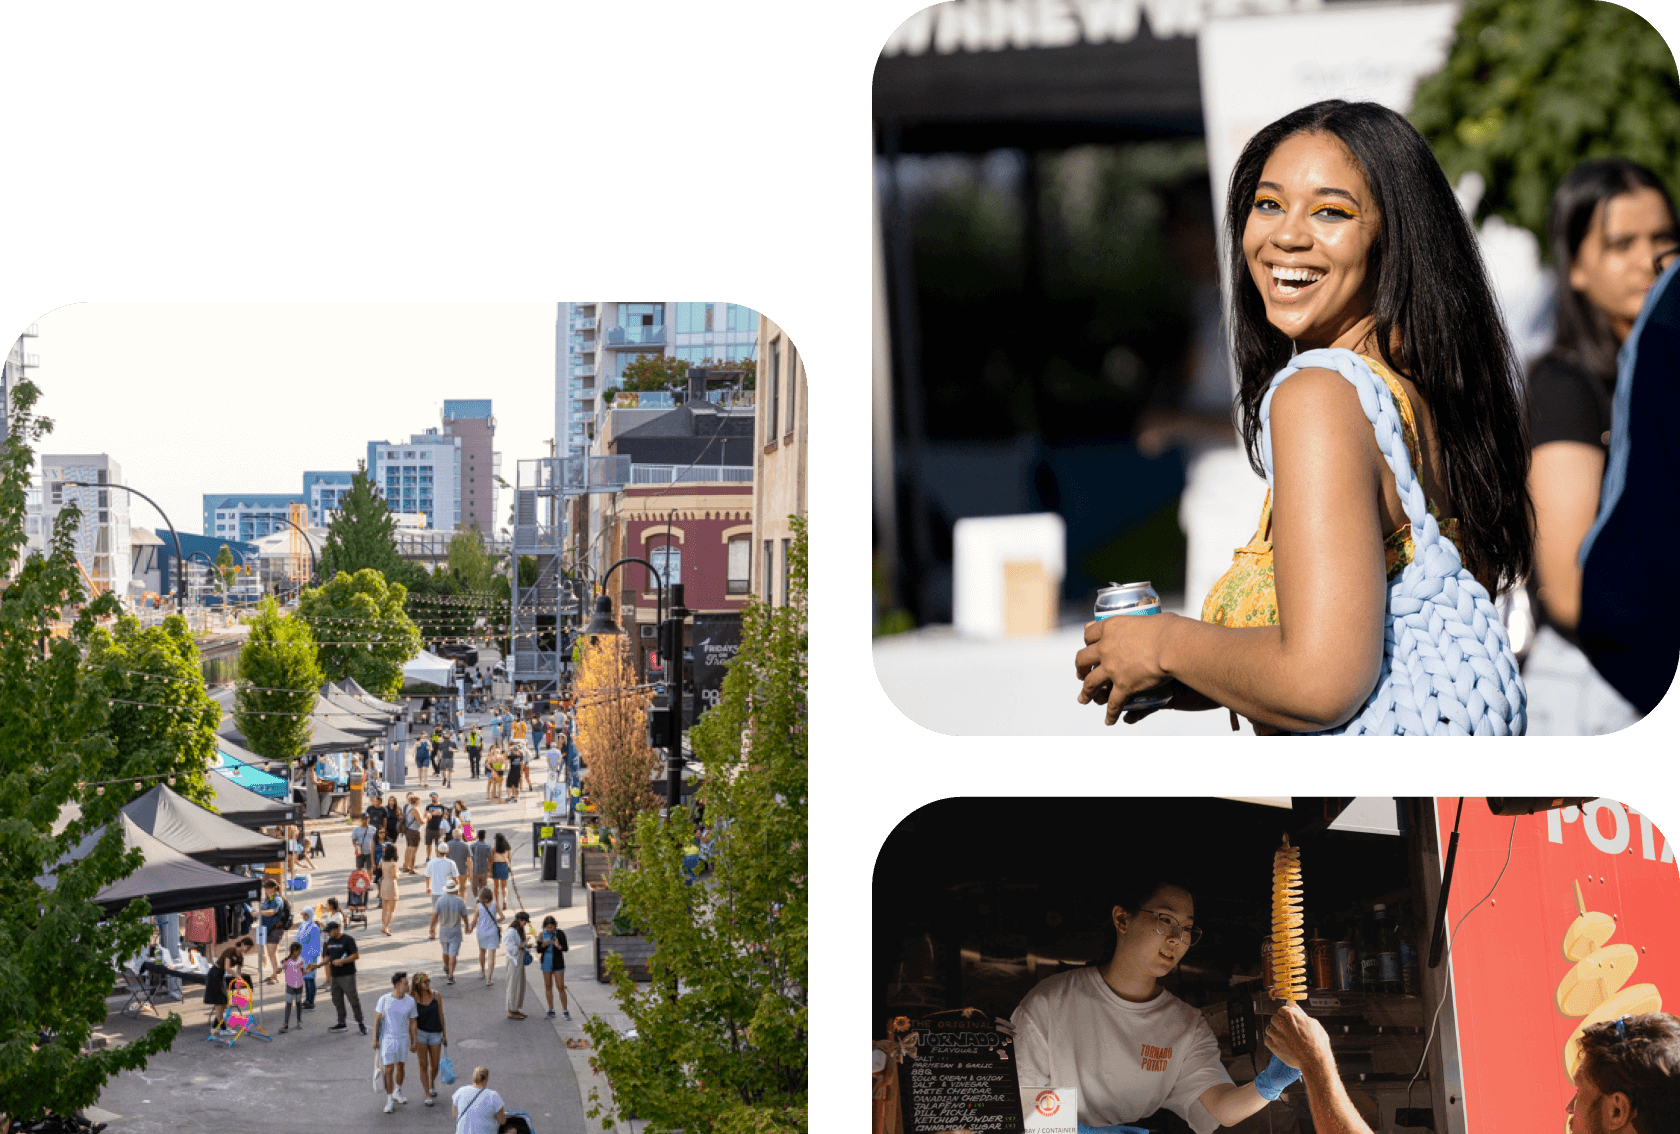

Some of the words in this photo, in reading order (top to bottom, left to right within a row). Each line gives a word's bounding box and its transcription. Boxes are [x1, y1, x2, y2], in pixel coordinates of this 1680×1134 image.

[910, 1019, 932, 1028] THE
[937, 1021, 993, 1029] ORIGINAL
[911, 1028, 999, 1047] TORNADO
[1141, 1044, 1173, 1060] TORNADO
[1141, 1057, 1168, 1072] POTATO
[911, 1068, 932, 1076] BBQ
[961, 1094, 1005, 1102] CHEDDAR
[914, 1109, 937, 1117] DILL
[939, 1108, 978, 1117] PICKLE
[914, 1116, 959, 1124] KETCHUP
[960, 1115, 1004, 1123] POWDER
[915, 1123, 967, 1132] CINNAMON
[968, 1123, 1002, 1131] SUGAR
